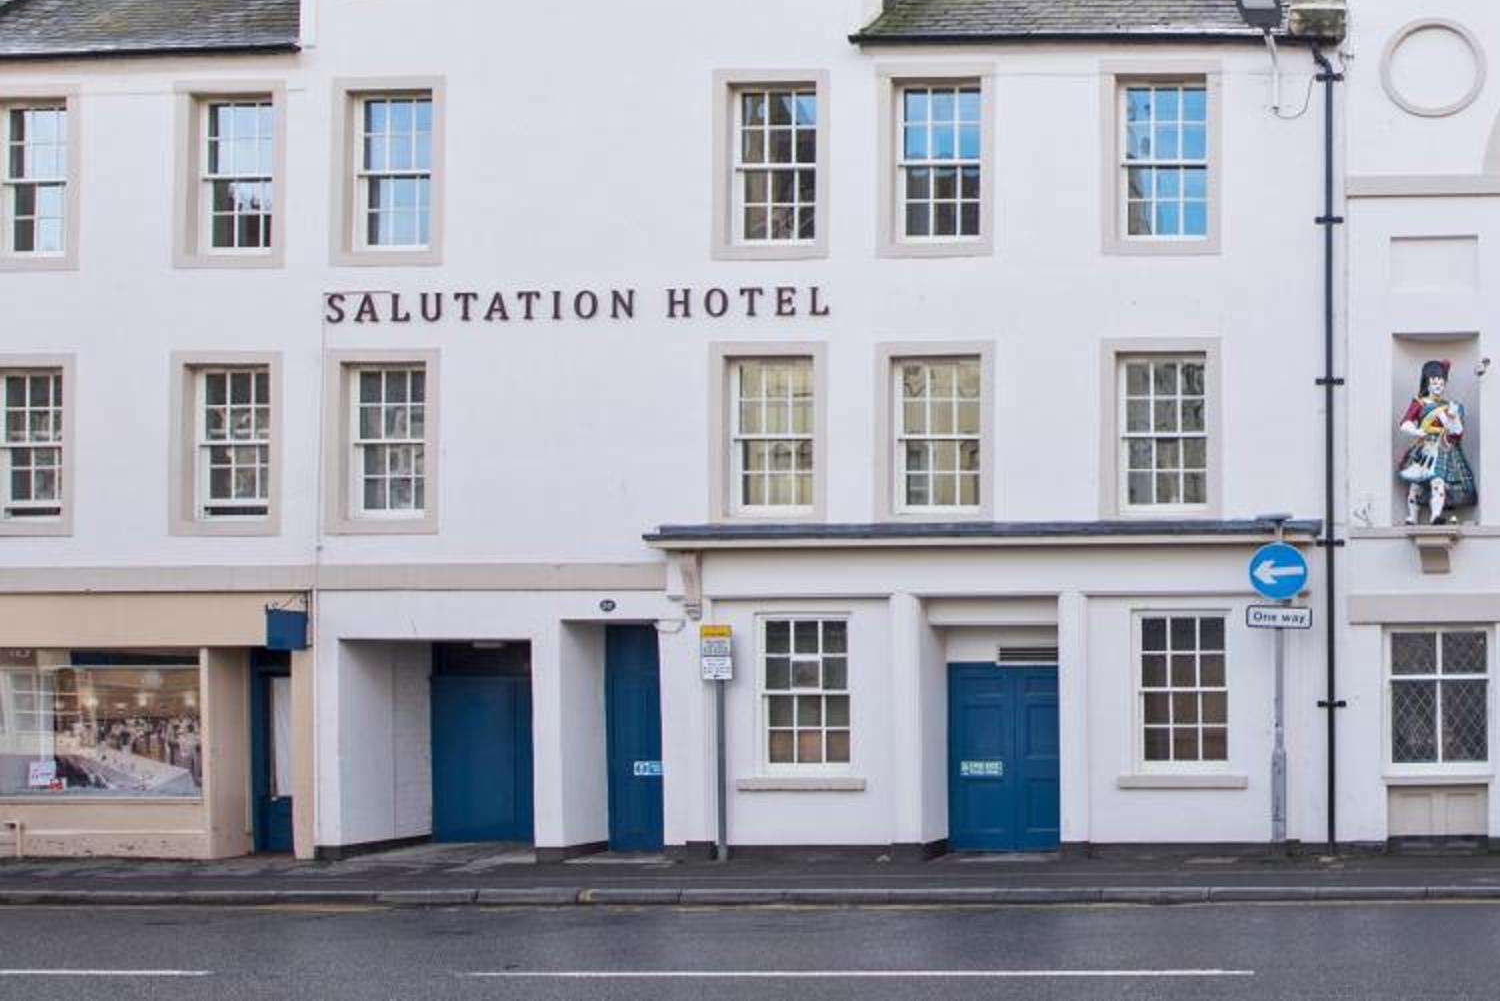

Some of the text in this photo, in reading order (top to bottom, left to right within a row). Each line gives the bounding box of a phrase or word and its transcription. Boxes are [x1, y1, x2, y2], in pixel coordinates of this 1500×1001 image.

[325, 286, 830, 323] SALUTATION HOTEL
[1253, 611, 1305, 624] One way
